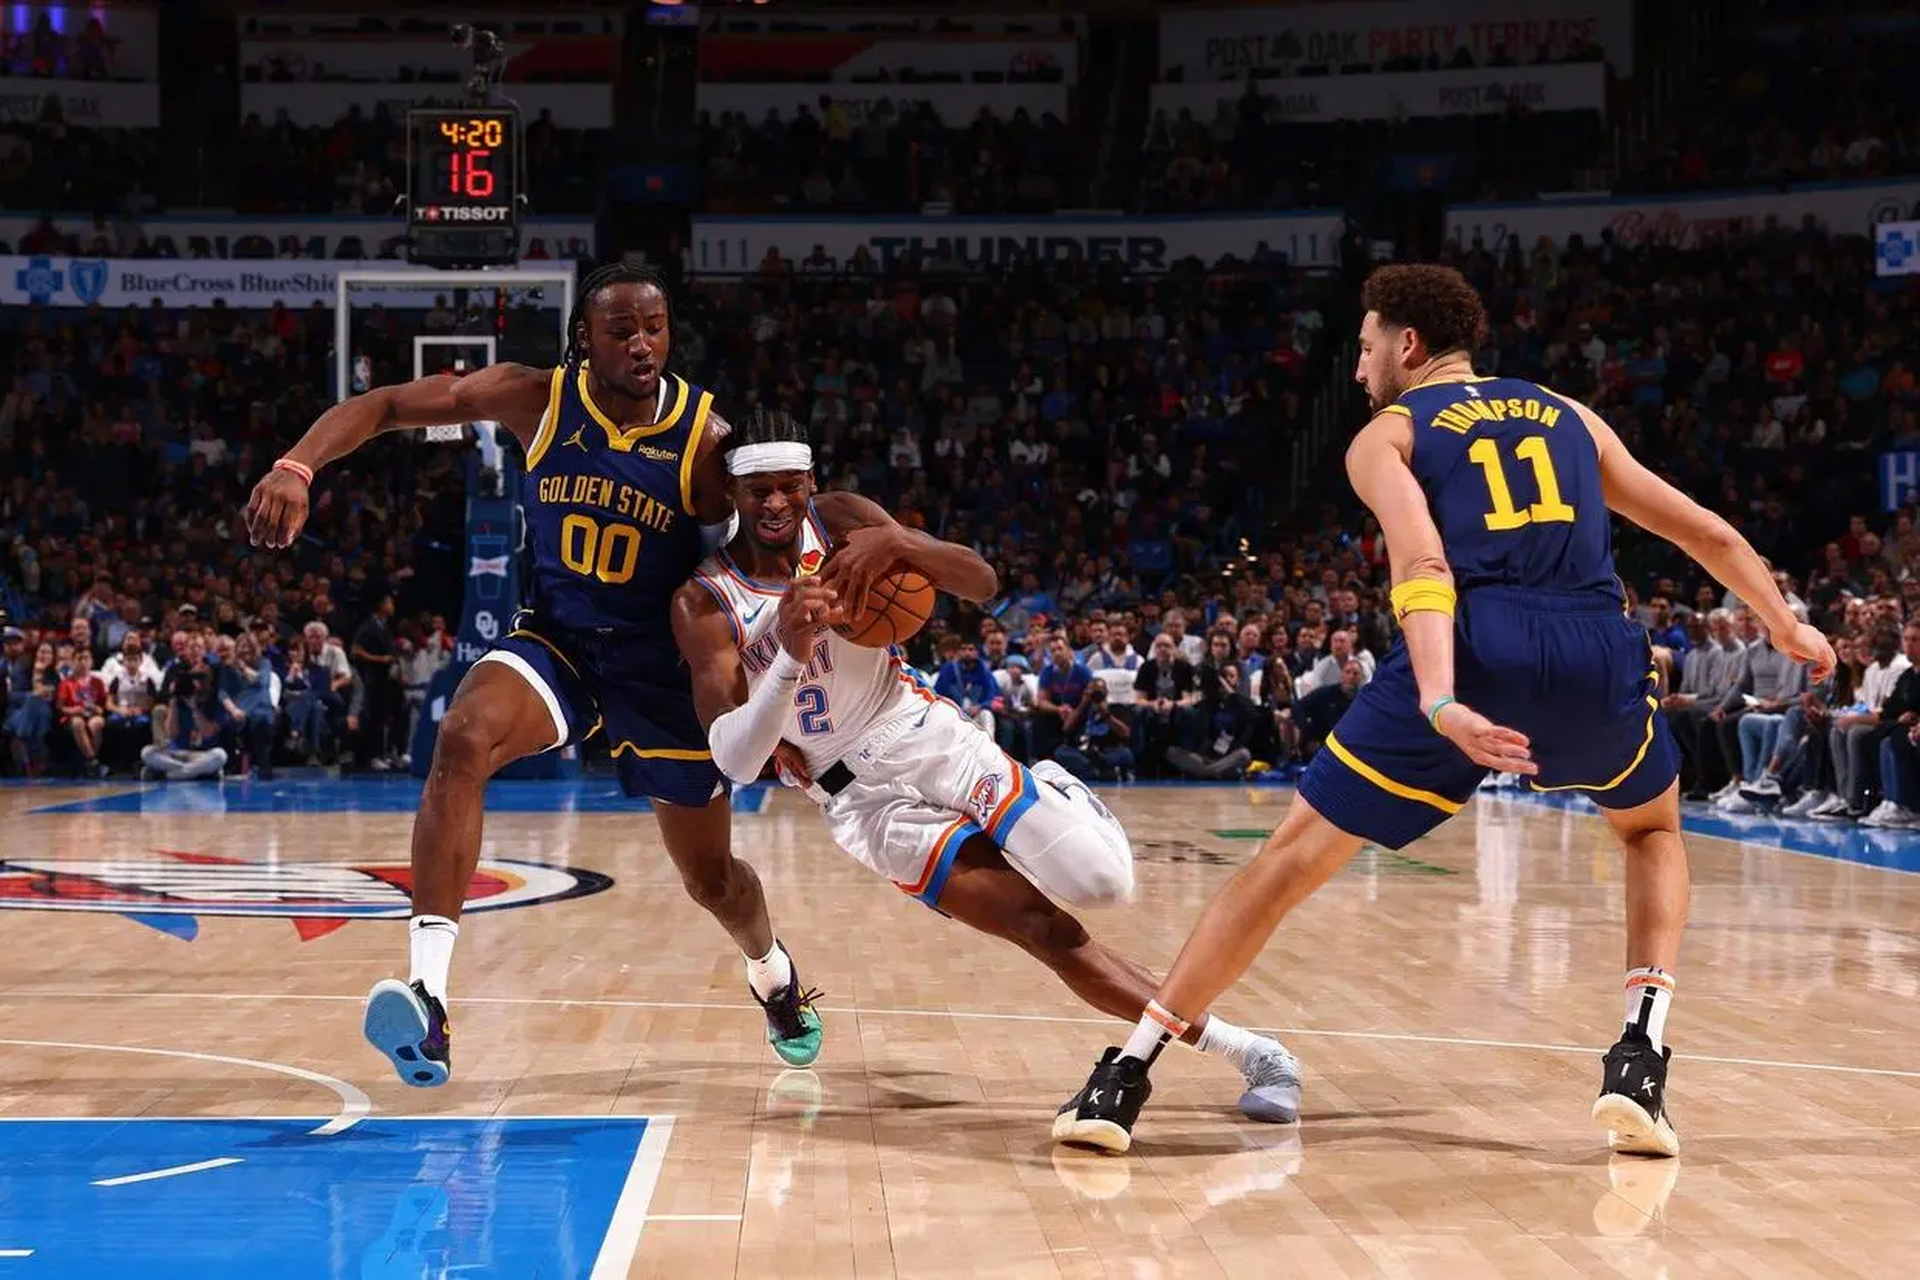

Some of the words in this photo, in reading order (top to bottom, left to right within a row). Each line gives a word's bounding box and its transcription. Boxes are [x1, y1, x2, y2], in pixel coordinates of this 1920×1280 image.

[1206, 36, 1265, 66] POST
[1307, 31, 1358, 62] OAK
[1368, 25, 1456, 60] PARTY
[1468, 17, 1597, 52] TERRACE
[441, 120, 502, 147] 4:20
[450, 150, 494, 197] 16
[440, 207, 509, 221] TISSOT
[700, 237, 748, 267] 111
[870, 236, 1167, 271] THUNDER
[121, 271, 235, 292] BlueCross
[1430, 398, 1562, 435] THOMPSON
[638, 443, 678, 461] Rakuten
[1467, 436, 1576, 531] 11
[539, 475, 615, 508] GOLDEN
[617, 485, 676, 533] STATE
[560, 512, 642, 585] 00
[795, 684, 834, 737] 2
